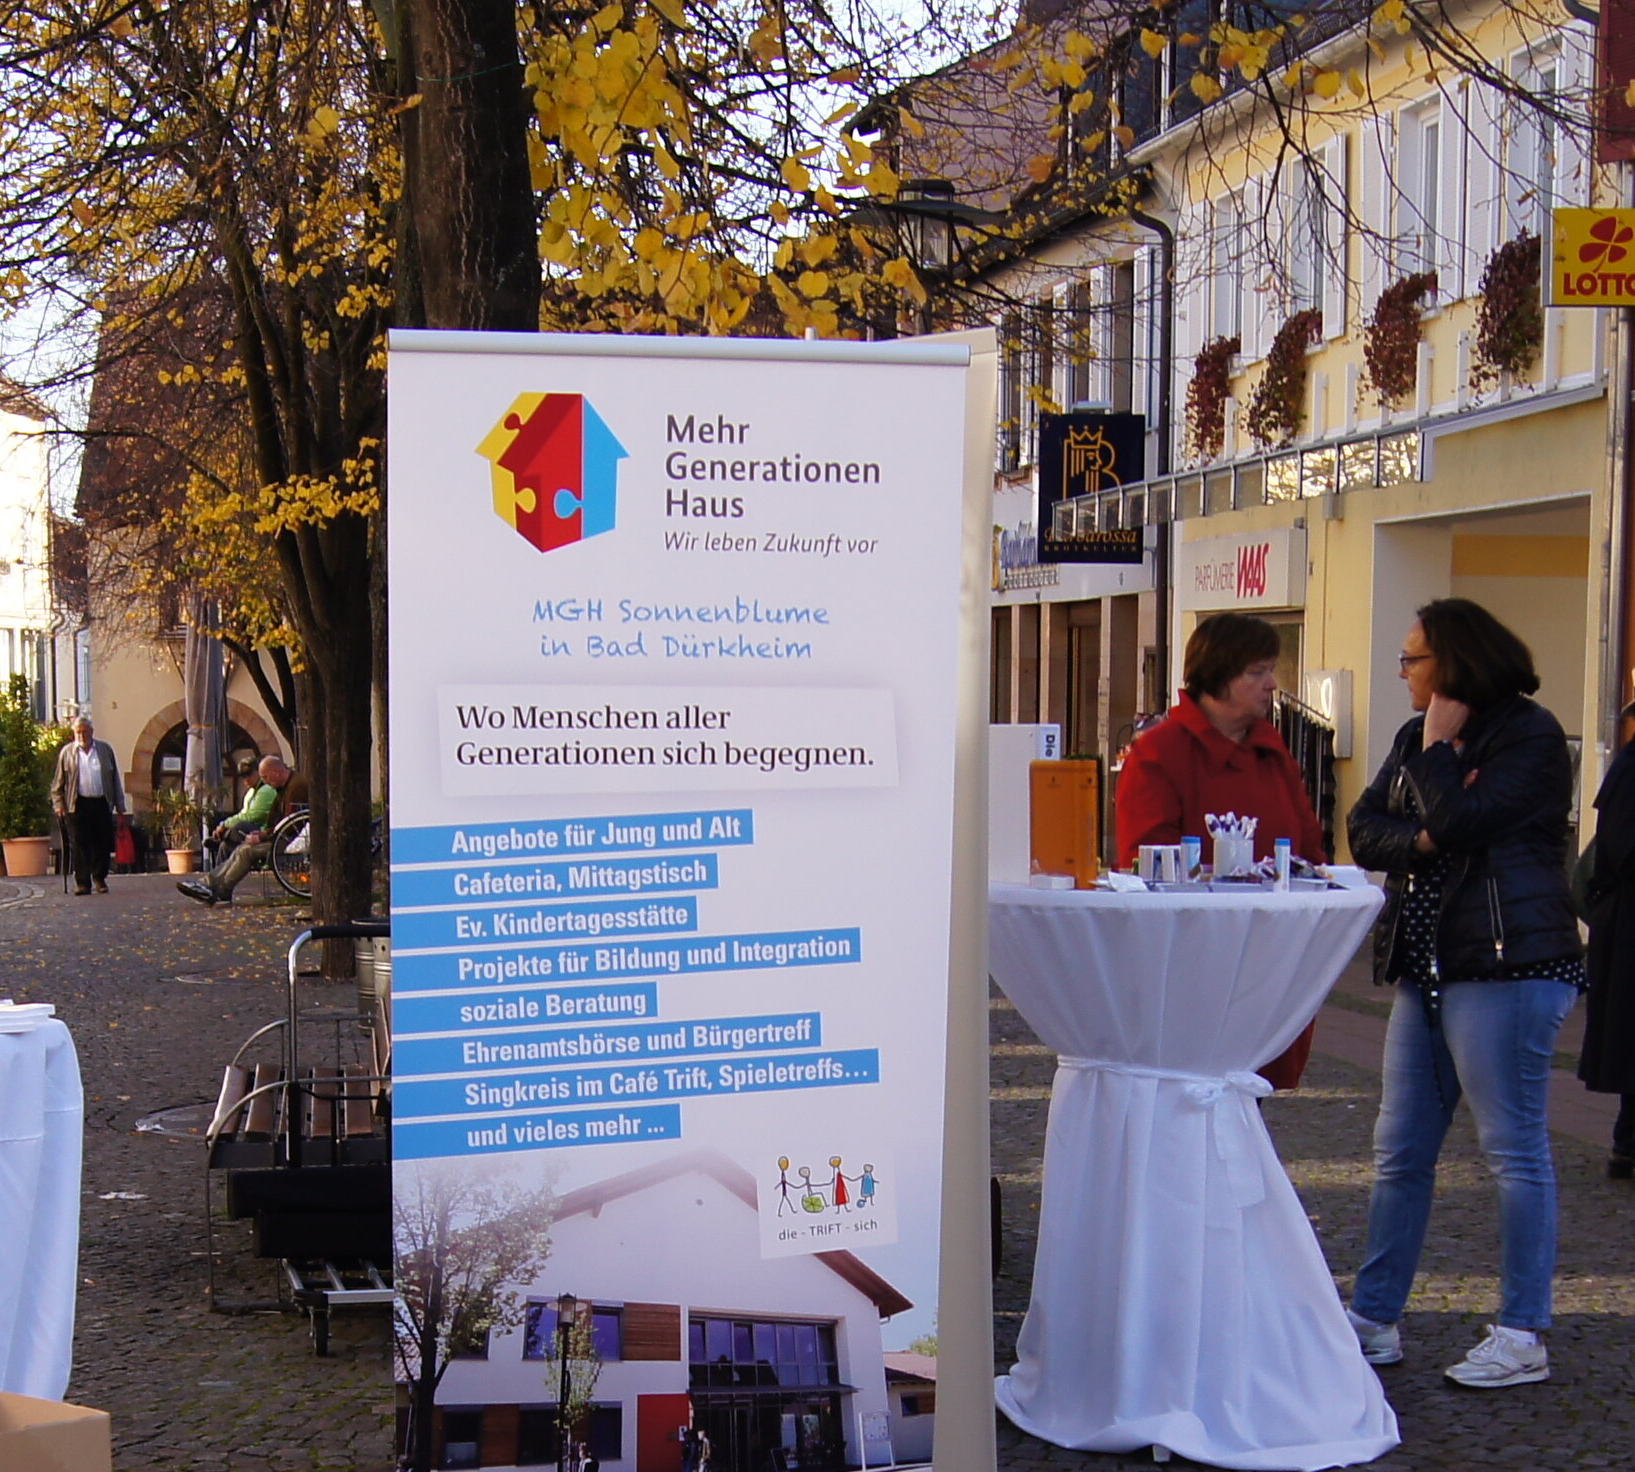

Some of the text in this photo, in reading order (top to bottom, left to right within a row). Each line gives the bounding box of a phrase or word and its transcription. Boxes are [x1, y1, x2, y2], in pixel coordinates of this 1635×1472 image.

[666, 414, 750, 443] Mehr
[666, 452, 880, 483] Generationen
[666, 488, 744, 518] Haus
[665, 531, 879, 558] Wir leben Zukunft vor
[533, 595, 830, 624] MGH Sonnenblume
[540, 631, 812, 658] in Bad Dürkheim
[456, 705, 732, 730] Wo Menschen aller
[456, 741, 875, 773] Generationen sich begegnen.
[1044, 734, 1056, 758] Die
[451, 816, 741, 857] Angebote für Jung und Alt
[453, 860, 707, 897] Cafeteria, Mittagstisch
[456, 905, 688, 938] Ev. Kindertagesstätte
[459, 935, 851, 983] Projekte für Bildung und Integration
[460, 990, 646, 1023] soziale Beratung
[463, 1018, 811, 1065] Ehrenamtsbörse und Bürgertreff
[465, 1077, 570, 1108] Singkreis
[576, 1074, 603, 1097] im
[609, 1070, 659, 1095] Café
[664, 1067, 713, 1092] Trift,
[467, 1125, 508, 1148] und
[513, 1119, 580, 1143] vieles
[585, 1114, 641, 1139] mehr
[778, 1227, 798, 1242] die
[809, 1223, 842, 1238] TRIFT
[854, 1219, 878, 1232] sich
